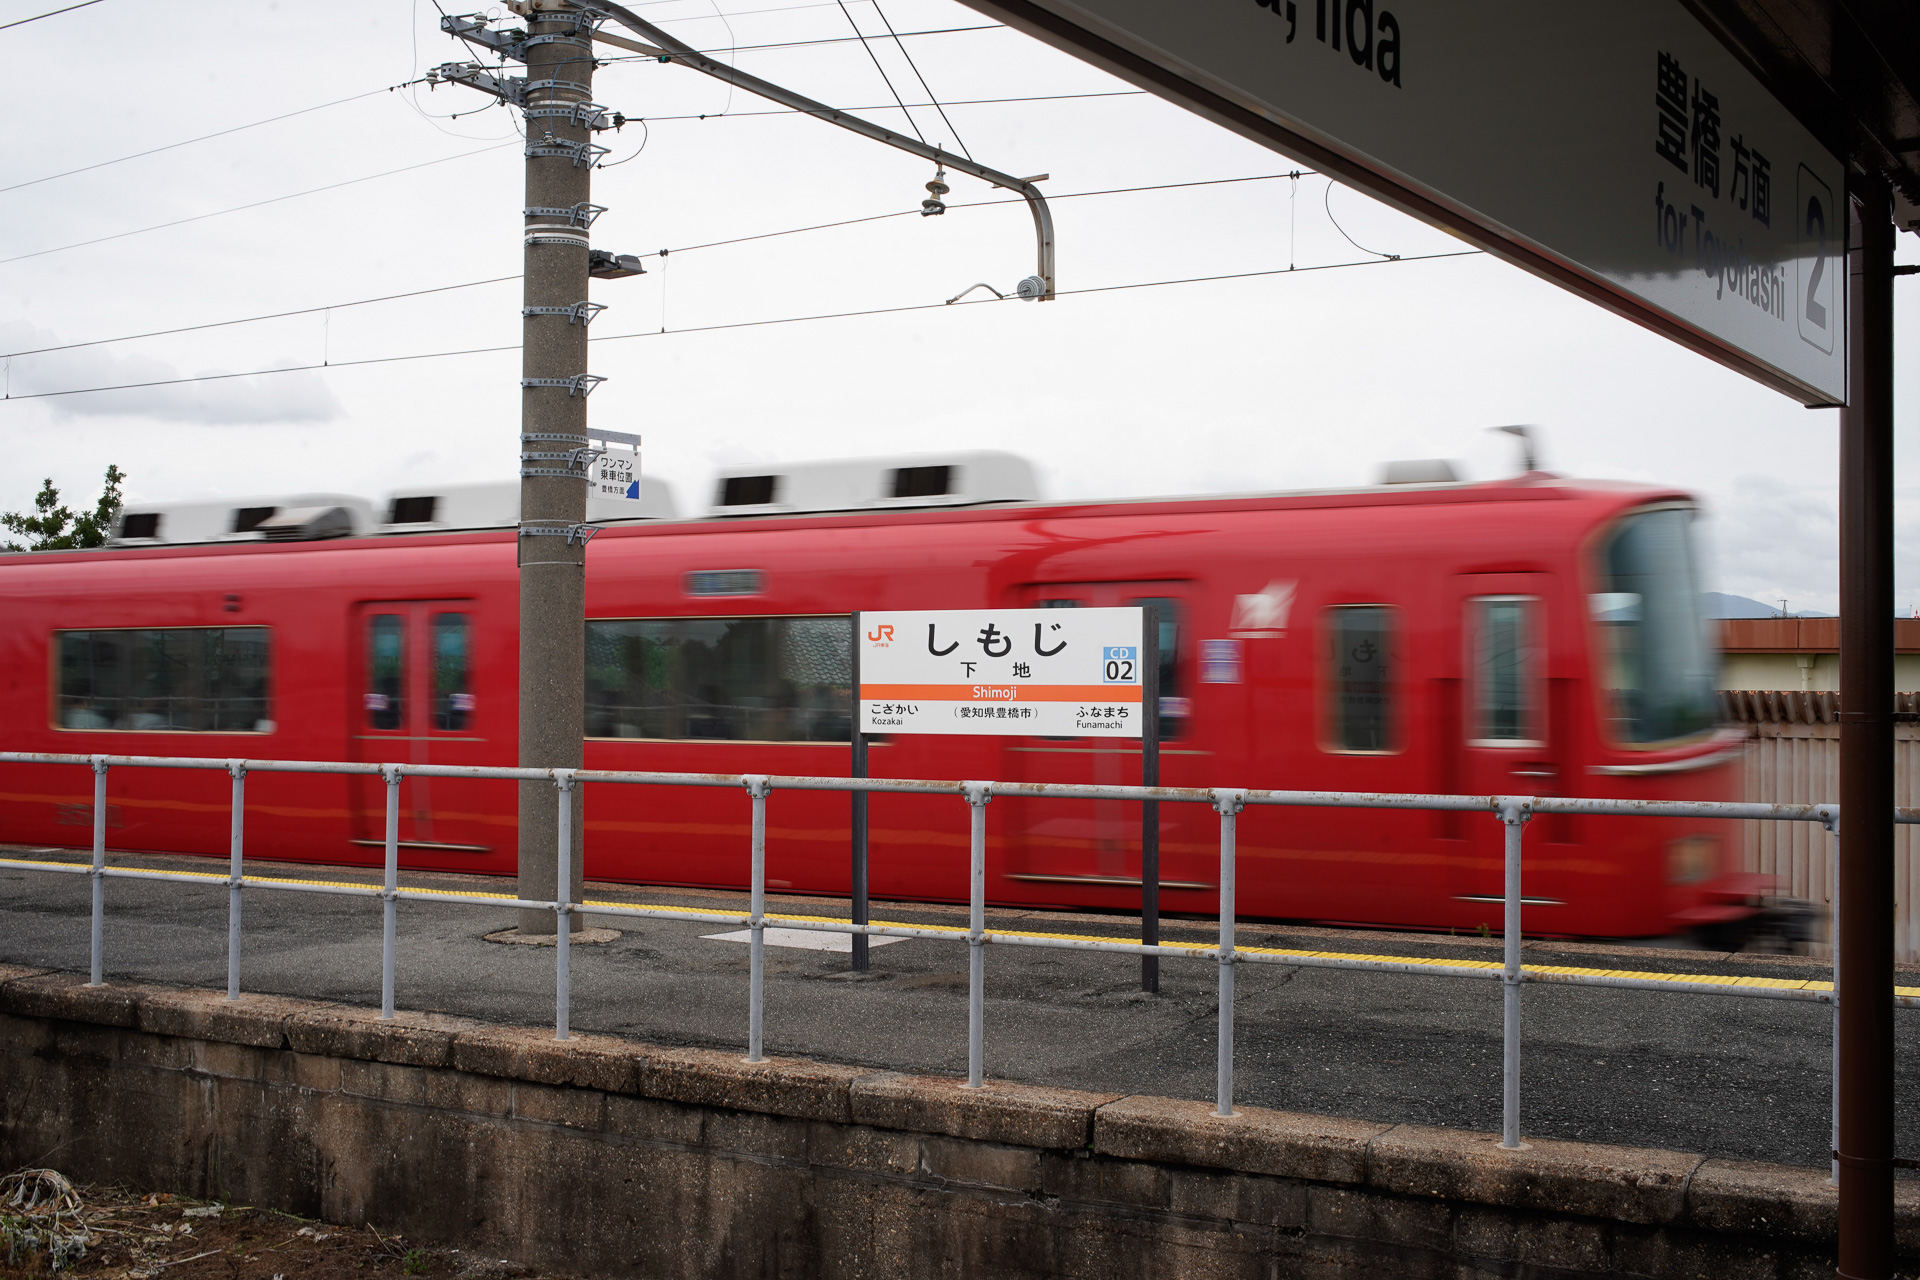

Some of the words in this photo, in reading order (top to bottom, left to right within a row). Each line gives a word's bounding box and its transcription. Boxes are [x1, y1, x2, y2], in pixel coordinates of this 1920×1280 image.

[1655, 181, 1687, 256] for
[1690, 204, 1785, 322] Toyohashi
[1805, 195, 1827, 331] 2
[600, 457, 633, 470] ワンマン
[600, 469, 633, 483] 乗車位置
[868, 624, 894, 642] JR
[927, 623, 1068, 658] しもじ
[1110, 648, 1129, 659] CD
[960, 661, 1031, 679] 下地
[1106, 660, 1133, 680] 02
[972, 686, 1017, 701] Shimoji
[870, 703, 919, 715] こざかい
[1076, 705, 1129, 718] ふなまち
[871, 716, 903, 726] Kozakai
[1076, 719, 1123, 729] Funamachi
